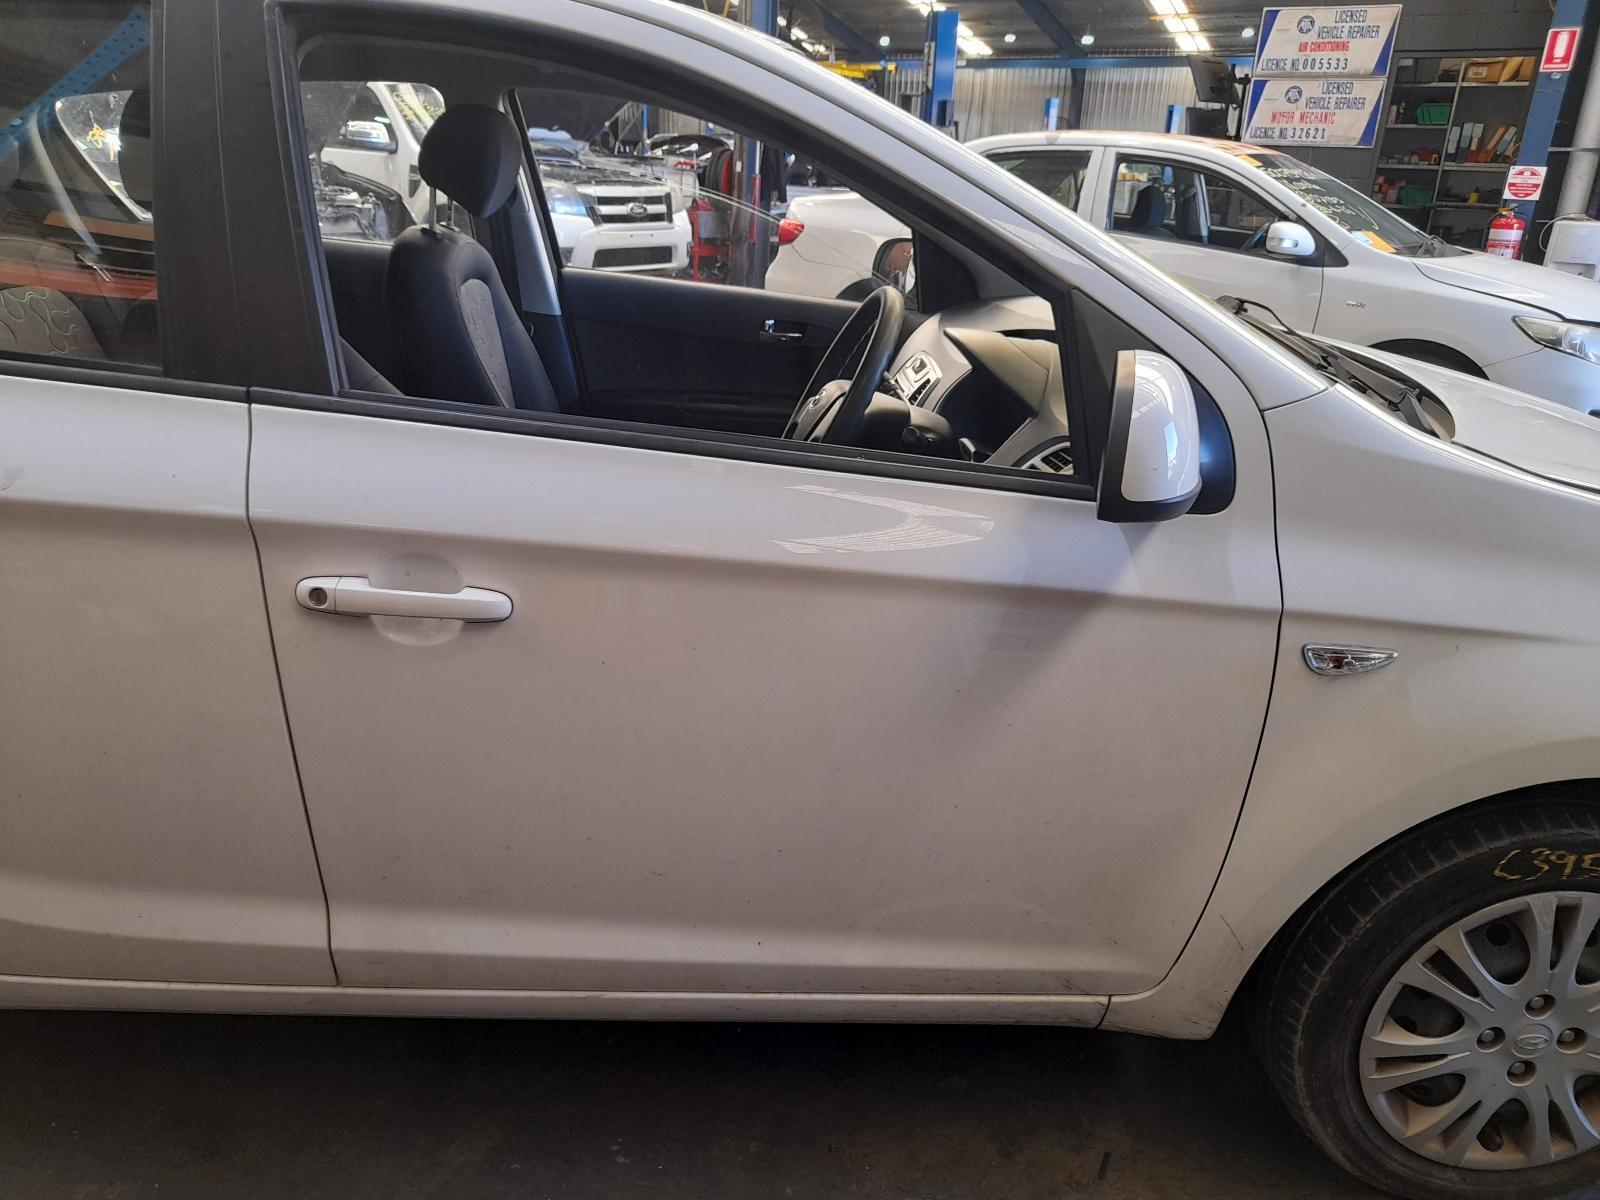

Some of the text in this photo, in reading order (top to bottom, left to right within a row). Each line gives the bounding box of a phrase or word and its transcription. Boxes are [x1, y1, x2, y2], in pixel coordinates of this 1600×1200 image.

[1335, 10, 1368, 24] LICENSED
[1317, 25, 1381, 39] VEHICLE REPAIRER
[1298, 41, 1350, 53] AIR CONDITIONING
[1261, 58, 1288, 71] LICENCE
[1302, 58, 1349, 70] 005533
[1322, 82, 1354, 95] LICENSED
[1305, 97, 1367, 110] VEHICLE REPAIRER
[1270, 111, 1337, 125] MOTOR MECHANIC
[1249, 127, 1276, 139] LICENCE
[1290, 127, 1327, 139] 32621
